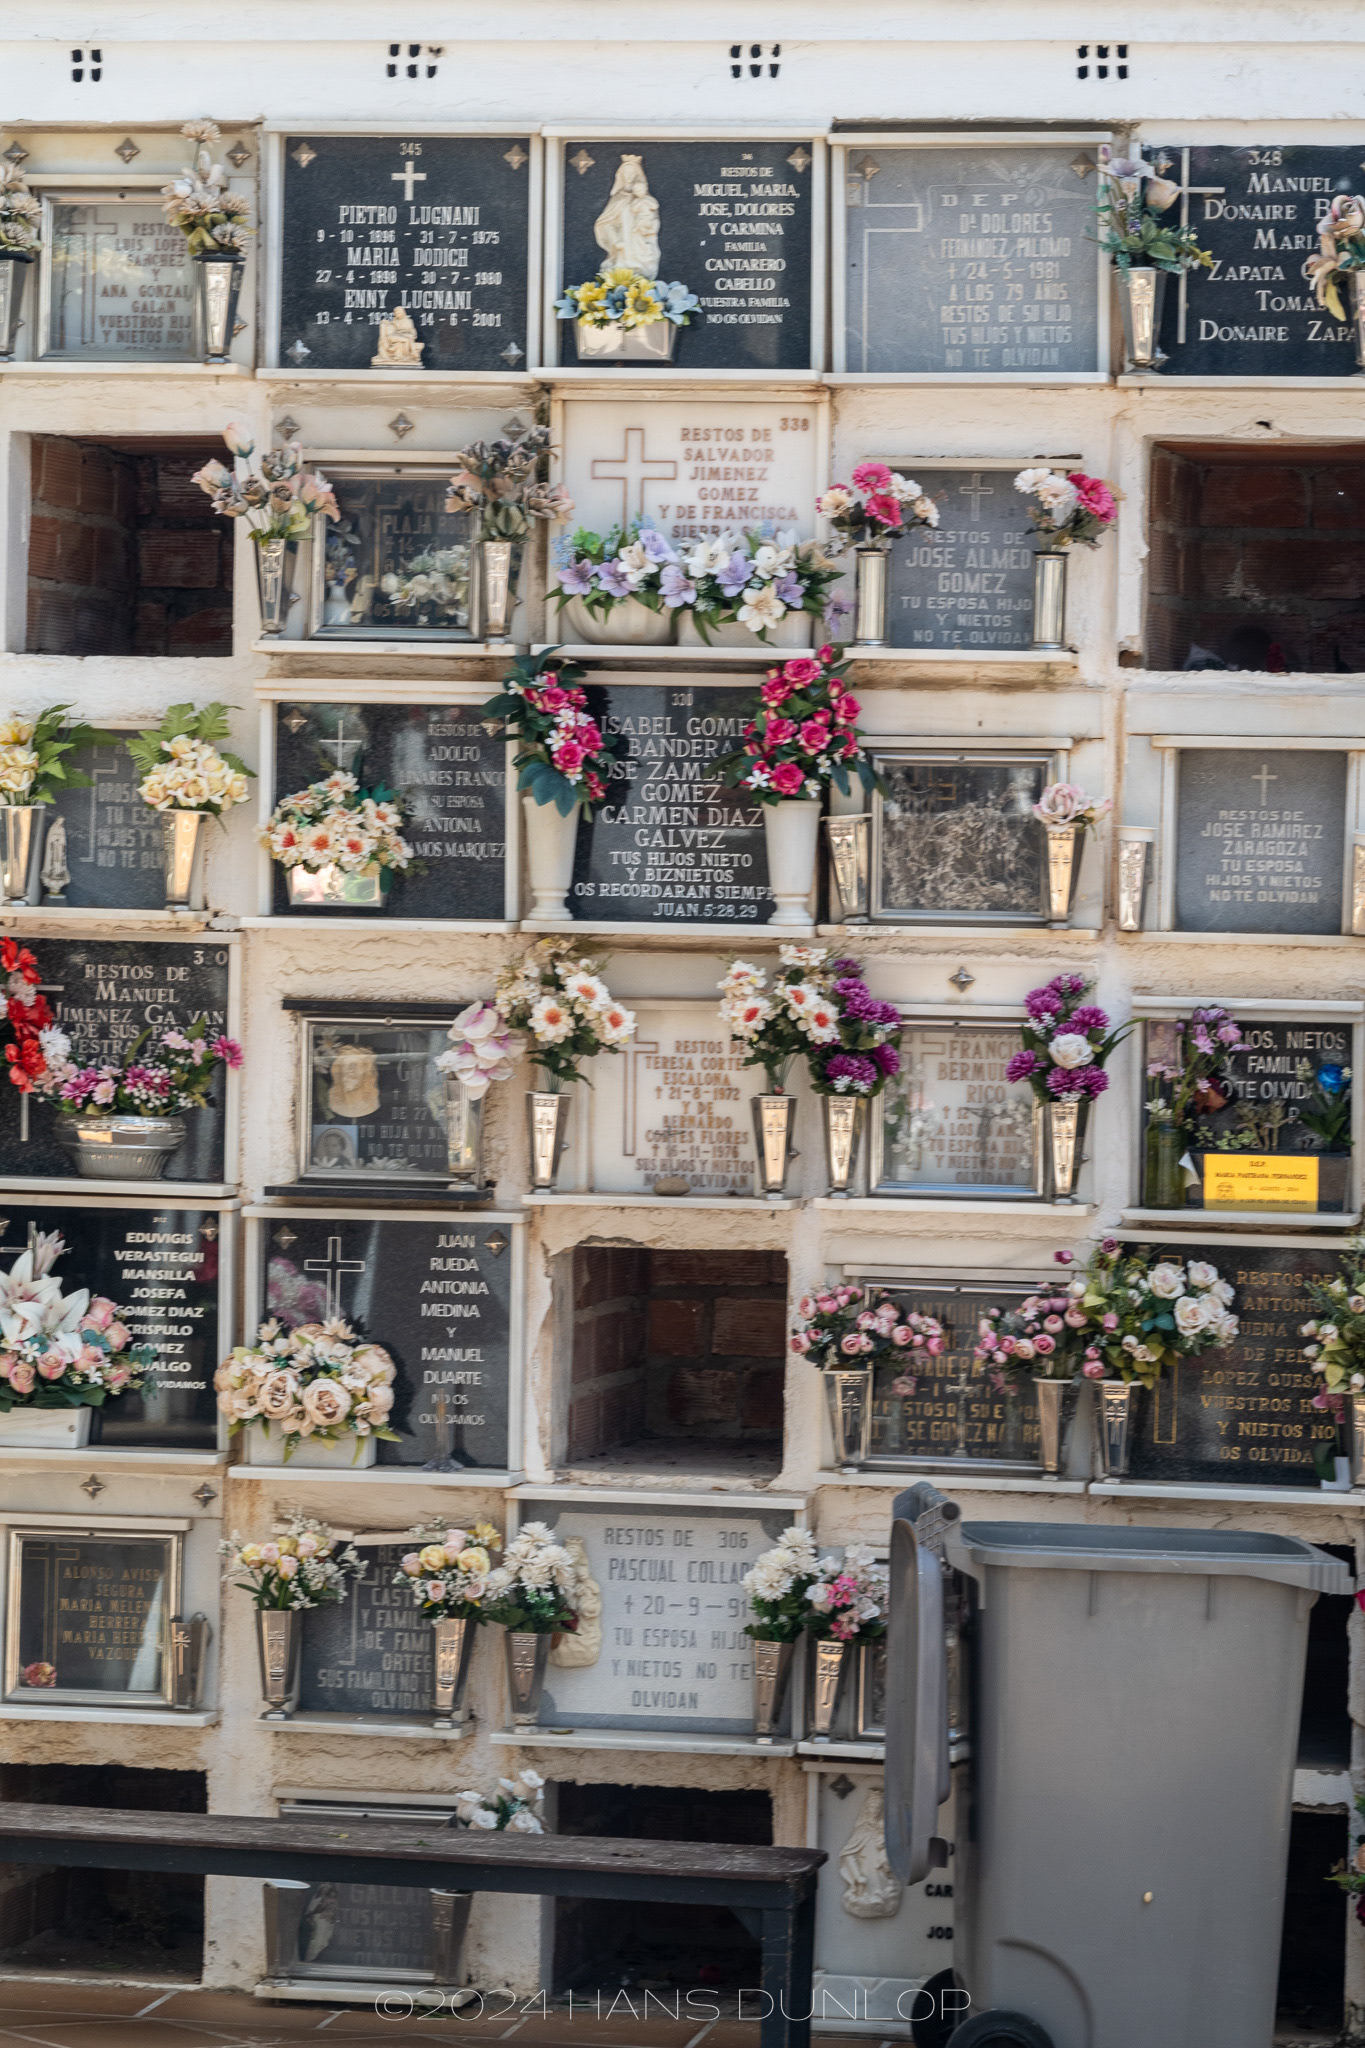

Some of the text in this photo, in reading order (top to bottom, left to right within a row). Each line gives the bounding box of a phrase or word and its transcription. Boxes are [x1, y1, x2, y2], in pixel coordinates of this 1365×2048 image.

[1248, 151, 1283, 166] 348
[1247, 173, 1336, 193] MANUEL
[750, 184, 800, 198] MARIA,
[339, 206, 480, 225] PIETRO LUGNANI
[698, 203, 795, 217] JOSE, DOLORES
[709, 223, 784, 235] Y CARMINA
[982, 213, 1053, 233] DOLORES
[725, 242, 766, 252] FAMILIA
[347, 247, 468, 267] MARIA DODICH
[705, 259, 786, 271] CANTARERO
[1207, 260, 1286, 281] ZAPATA
[715, 278, 775, 290] CABELLO
[344, 290, 472, 309] ENNY LUGNANI
[748, 298, 790, 307] FAMILIA
[1199, 319, 1289, 341] DONAIRE
[779, 417, 809, 432] 338
[680, 428, 772, 442] RESTOS DE
[684, 448, 774, 462] SALVADOR
[690, 467, 768, 481] JIMENEZ
[698, 487, 759, 501] GOMEZ
[658, 505, 798, 521] Y DE FRANCISCA
[1003, 532, 1025, 544] DE
[905, 547, 955, 569] JOSE
[938, 572, 1007, 594] GOMEZ
[901, 596, 989, 610] TU ESPOSA
[936, 614, 1012, 627] Y NIETOS
[913, 630, 962, 643] NO TE
[601, 716, 678, 735] ISABEL
[430, 746, 481, 762] ADOLFO
[641, 783, 722, 803] GOMEZ
[601, 806, 764, 827] CARMEN DIAZ
[1219, 811, 1304, 821] RESTOS DE
[422, 818, 482, 832] ANTONIA
[1201, 822, 1324, 839] JOSE RAMIREZ
[634, 829, 727, 848] GALVEZ
[444, 842, 506, 860] MARQUEZ
[1223, 841, 1308, 856] ZARAGOZA
[609, 852, 641, 865] TUS
[647, 853, 696, 866] HIJOS
[1220, 859, 1303, 873] TU ESPOSA
[626, 868, 734, 882] Y BIZNIETOS
[1205, 875, 1323, 888] HIJOS Y NIETOS
[574, 883, 711, 899] OS RECORDARAN
[1210, 891, 1319, 903] NO TE OLVIDAN
[85, 965, 190, 981] RESTOS DE
[95, 981, 180, 1002] MANUEL
[54, 1002, 133, 1023] JIMENEZ
[109, 1025, 140, 1039] SUS
[1286, 1031, 1346, 1049] NIETOS
[675, 1041, 746, 1054] RESTOS DE
[645, 1056, 695, 1070] TERESA
[663, 1072, 731, 1086] ESCALONA
[967, 1085, 1006, 1103] RICO
[682, 1102, 714, 1115] Y DE
[663, 1116, 733, 1129] BERNARDO
[701, 1131, 749, 1144] FLORES
[712, 1160, 755, 1173] NIETOS
[126, 1233, 194, 1244] EDUVIGIS
[436, 1234, 475, 1248] JUAN
[114, 1250, 204, 1263] VERASTEGUI
[430, 1257, 479, 1271] RUEDA
[122, 1269, 196, 1281] MANSILLA
[1237, 1271, 1303, 1287] RESTOS
[130, 1288, 186, 1299] JOSEFA
[420, 1280, 489, 1295] ANTONIA
[115, 1305, 204, 1318] GOMEZ DIAZ
[421, 1303, 481, 1317] MEDINA
[126, 1324, 193, 1336] CRISPULO
[446, 1326, 457, 1338] Y
[421, 1347, 485, 1362] MANUEL
[1244, 1348, 1266, 1361] DE
[423, 1371, 482, 1385] DUARTE
[1202, 1370, 1260, 1386] LOPEZ
[1200, 1395, 1292, 1412] VUESTROS
[1217, 1421, 1335, 1439] Y NIETOS NO
[1220, 1447, 1241, 1460] OS
[604, 1528, 748, 1548] RESTOS DE 306
[63, 1565, 113, 1580] ALONSO
[609, 1557, 676, 1582] PASCUAL
[95, 1584, 145, 1598] SEGURA
[59, 1598, 102, 1611] MARIA
[62, 1631, 106, 1644] MARIA
[614, 1627, 697, 1648] TU ESPOSA
[612, 1659, 622, 1676] Y
[626, 1660, 682, 1679] NIETOS
[696, 1662, 717, 1679] NO
[632, 1690, 699, 1709] OLVIDAN
